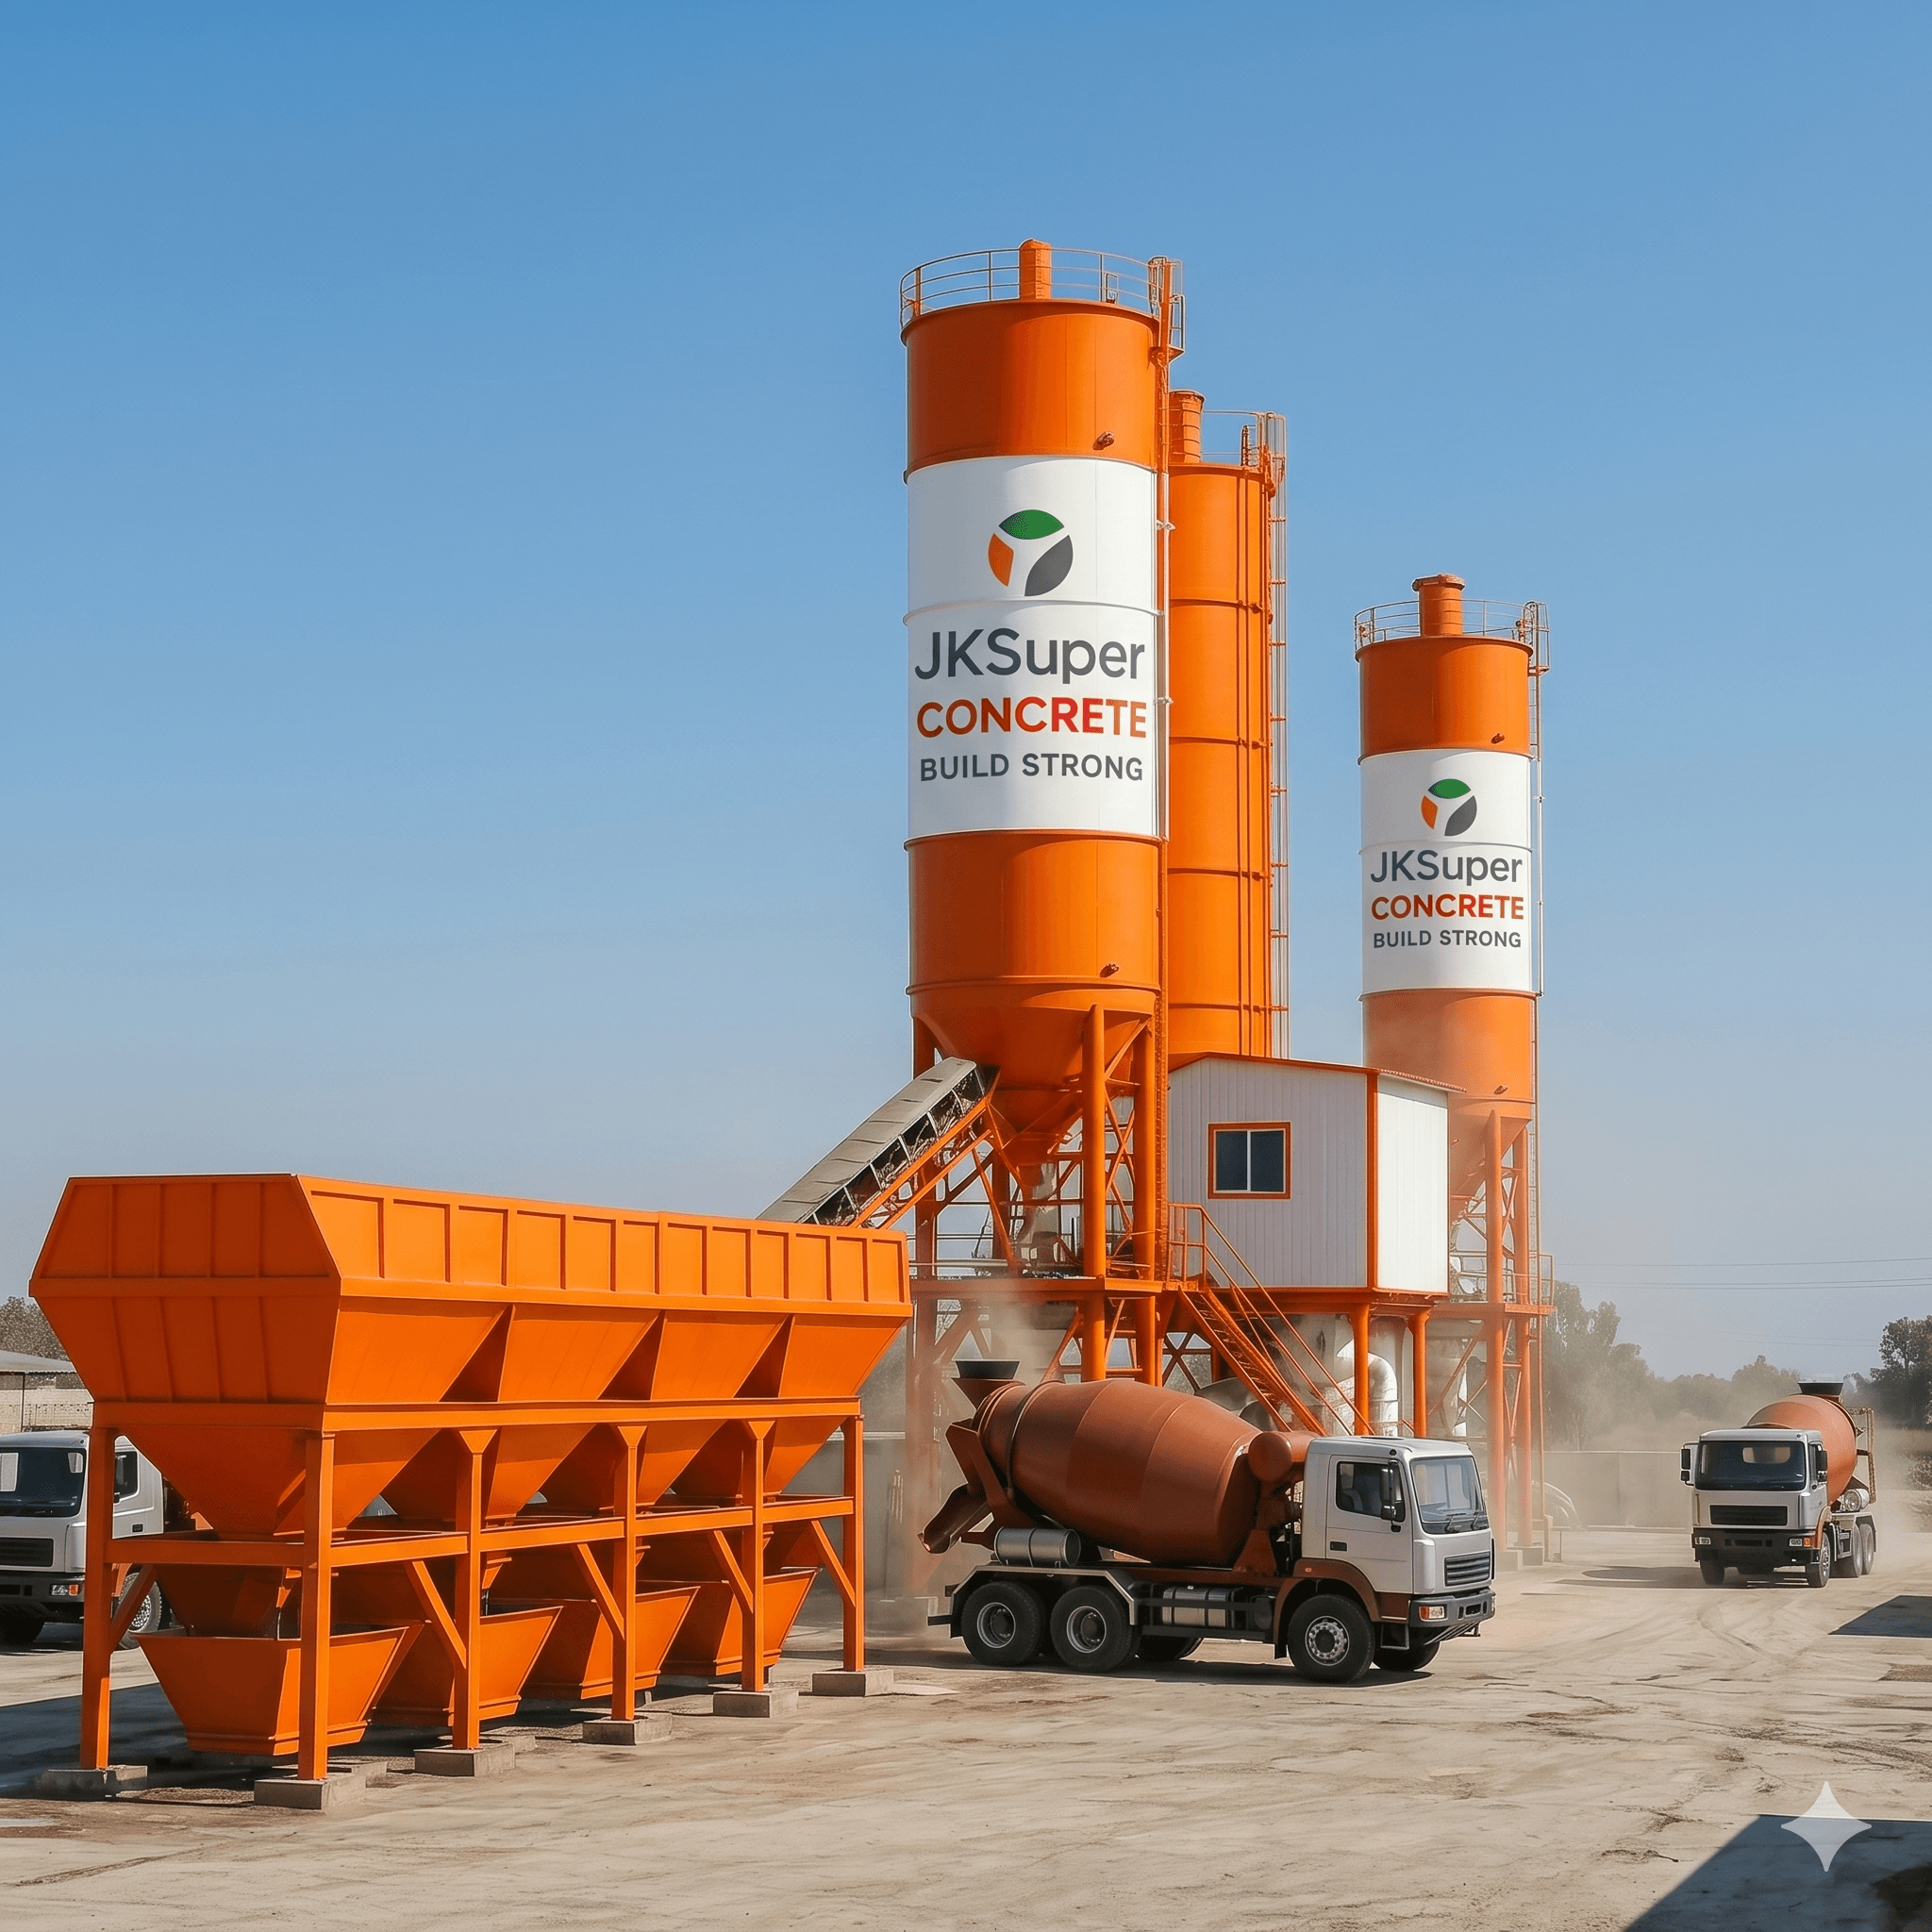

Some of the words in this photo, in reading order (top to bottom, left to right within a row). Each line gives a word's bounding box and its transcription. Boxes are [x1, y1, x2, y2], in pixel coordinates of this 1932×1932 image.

[914, 627, 1145, 685] JKSuper
[917, 696, 1147, 739] CONCRETE
[920, 754, 1009, 782] BUILD
[1022, 753, 1143, 781] STRONG
[1370, 849, 1523, 887] JKSuper
[1371, 893, 1524, 921] CONCRETE
[1373, 930, 1432, 949] BUILD
[1440, 929, 1522, 948] STRONG
